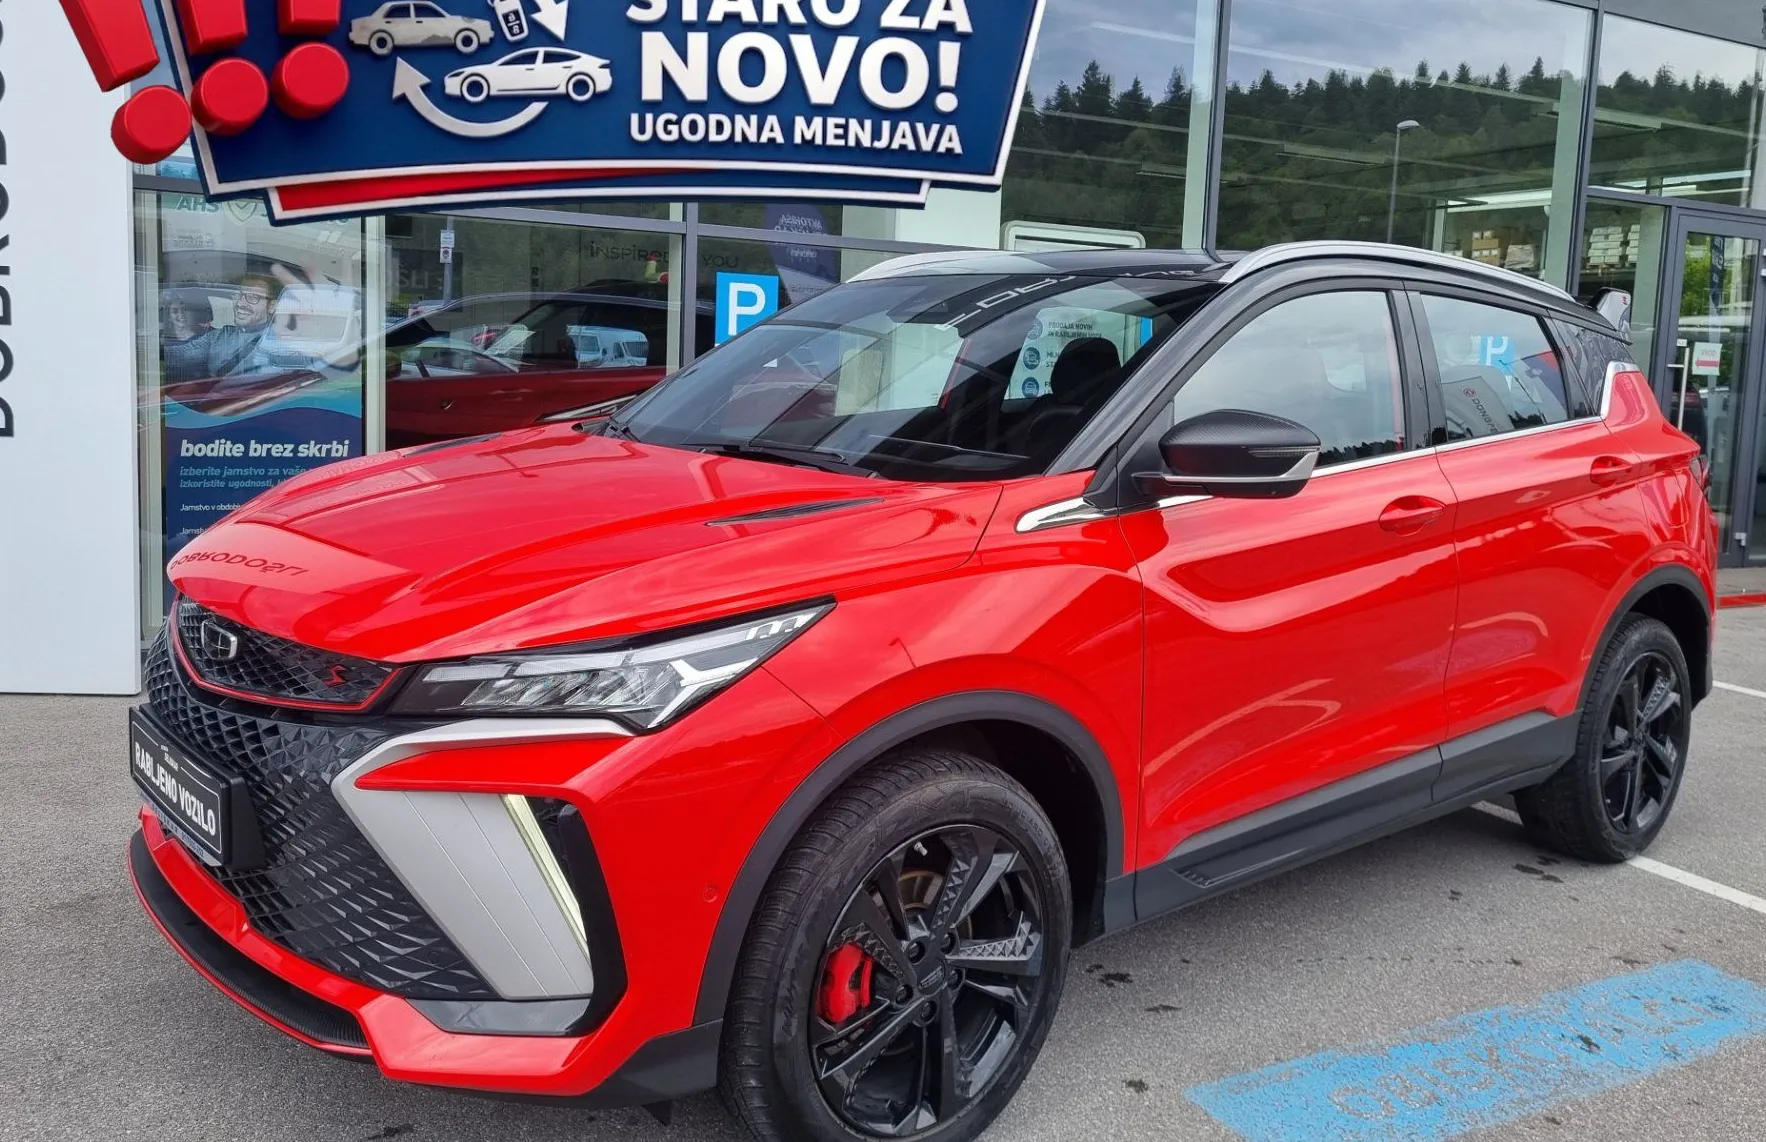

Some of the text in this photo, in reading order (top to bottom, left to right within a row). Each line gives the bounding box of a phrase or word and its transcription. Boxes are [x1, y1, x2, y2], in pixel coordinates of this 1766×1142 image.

[702, 254, 740, 268] YOU
[728, 282, 766, 336] P
[180, 438, 350, 458] bodite brez skrbi
[180, 466, 221, 476] izberite
[222, 466, 265, 478] jamstvo
[267, 468, 280, 476] za
[180, 479, 226, 488] izkoristite
[228, 479, 275, 489] ugodnosti,
[134, 741, 178, 804] RABLJENO
[178, 783, 216, 836] VOZILO
